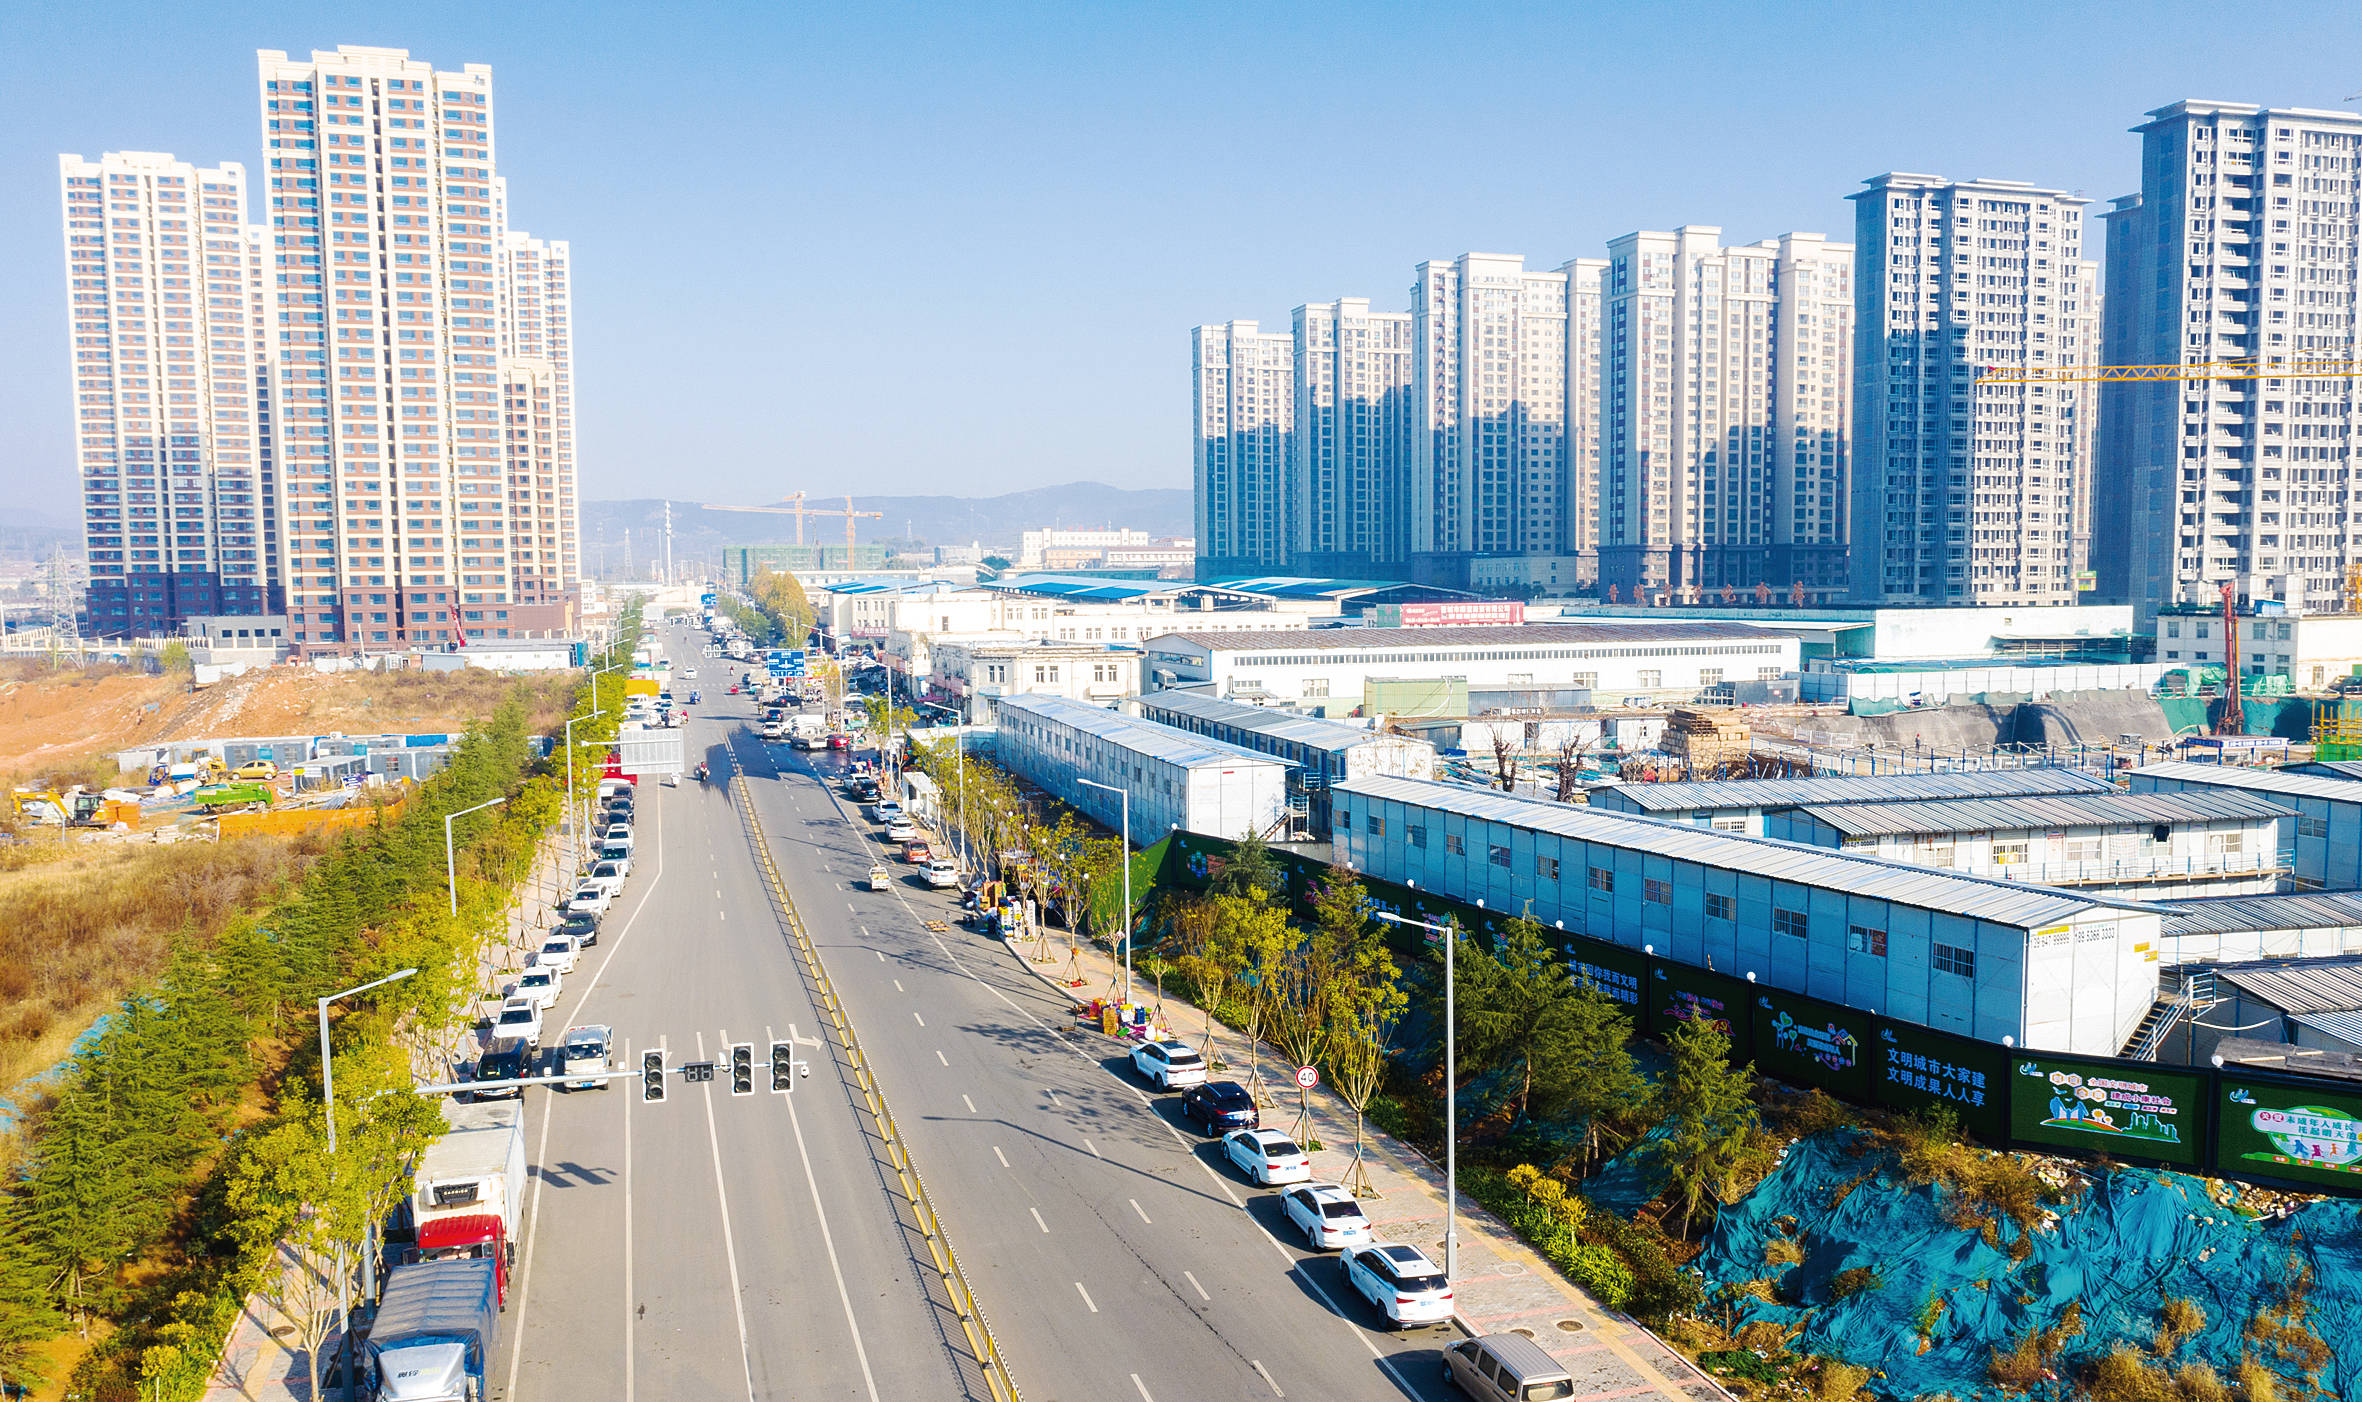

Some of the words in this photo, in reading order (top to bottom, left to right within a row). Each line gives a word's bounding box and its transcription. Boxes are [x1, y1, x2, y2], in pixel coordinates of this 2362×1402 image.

[1301, 1072, 1314, 1083] 40
[1887, 1047, 1986, 1089] 文明城市大家建
[1887, 1066, 1985, 1107] 文明成果人人享
[2111, 1091, 2171, 1106] 建成小康社会
